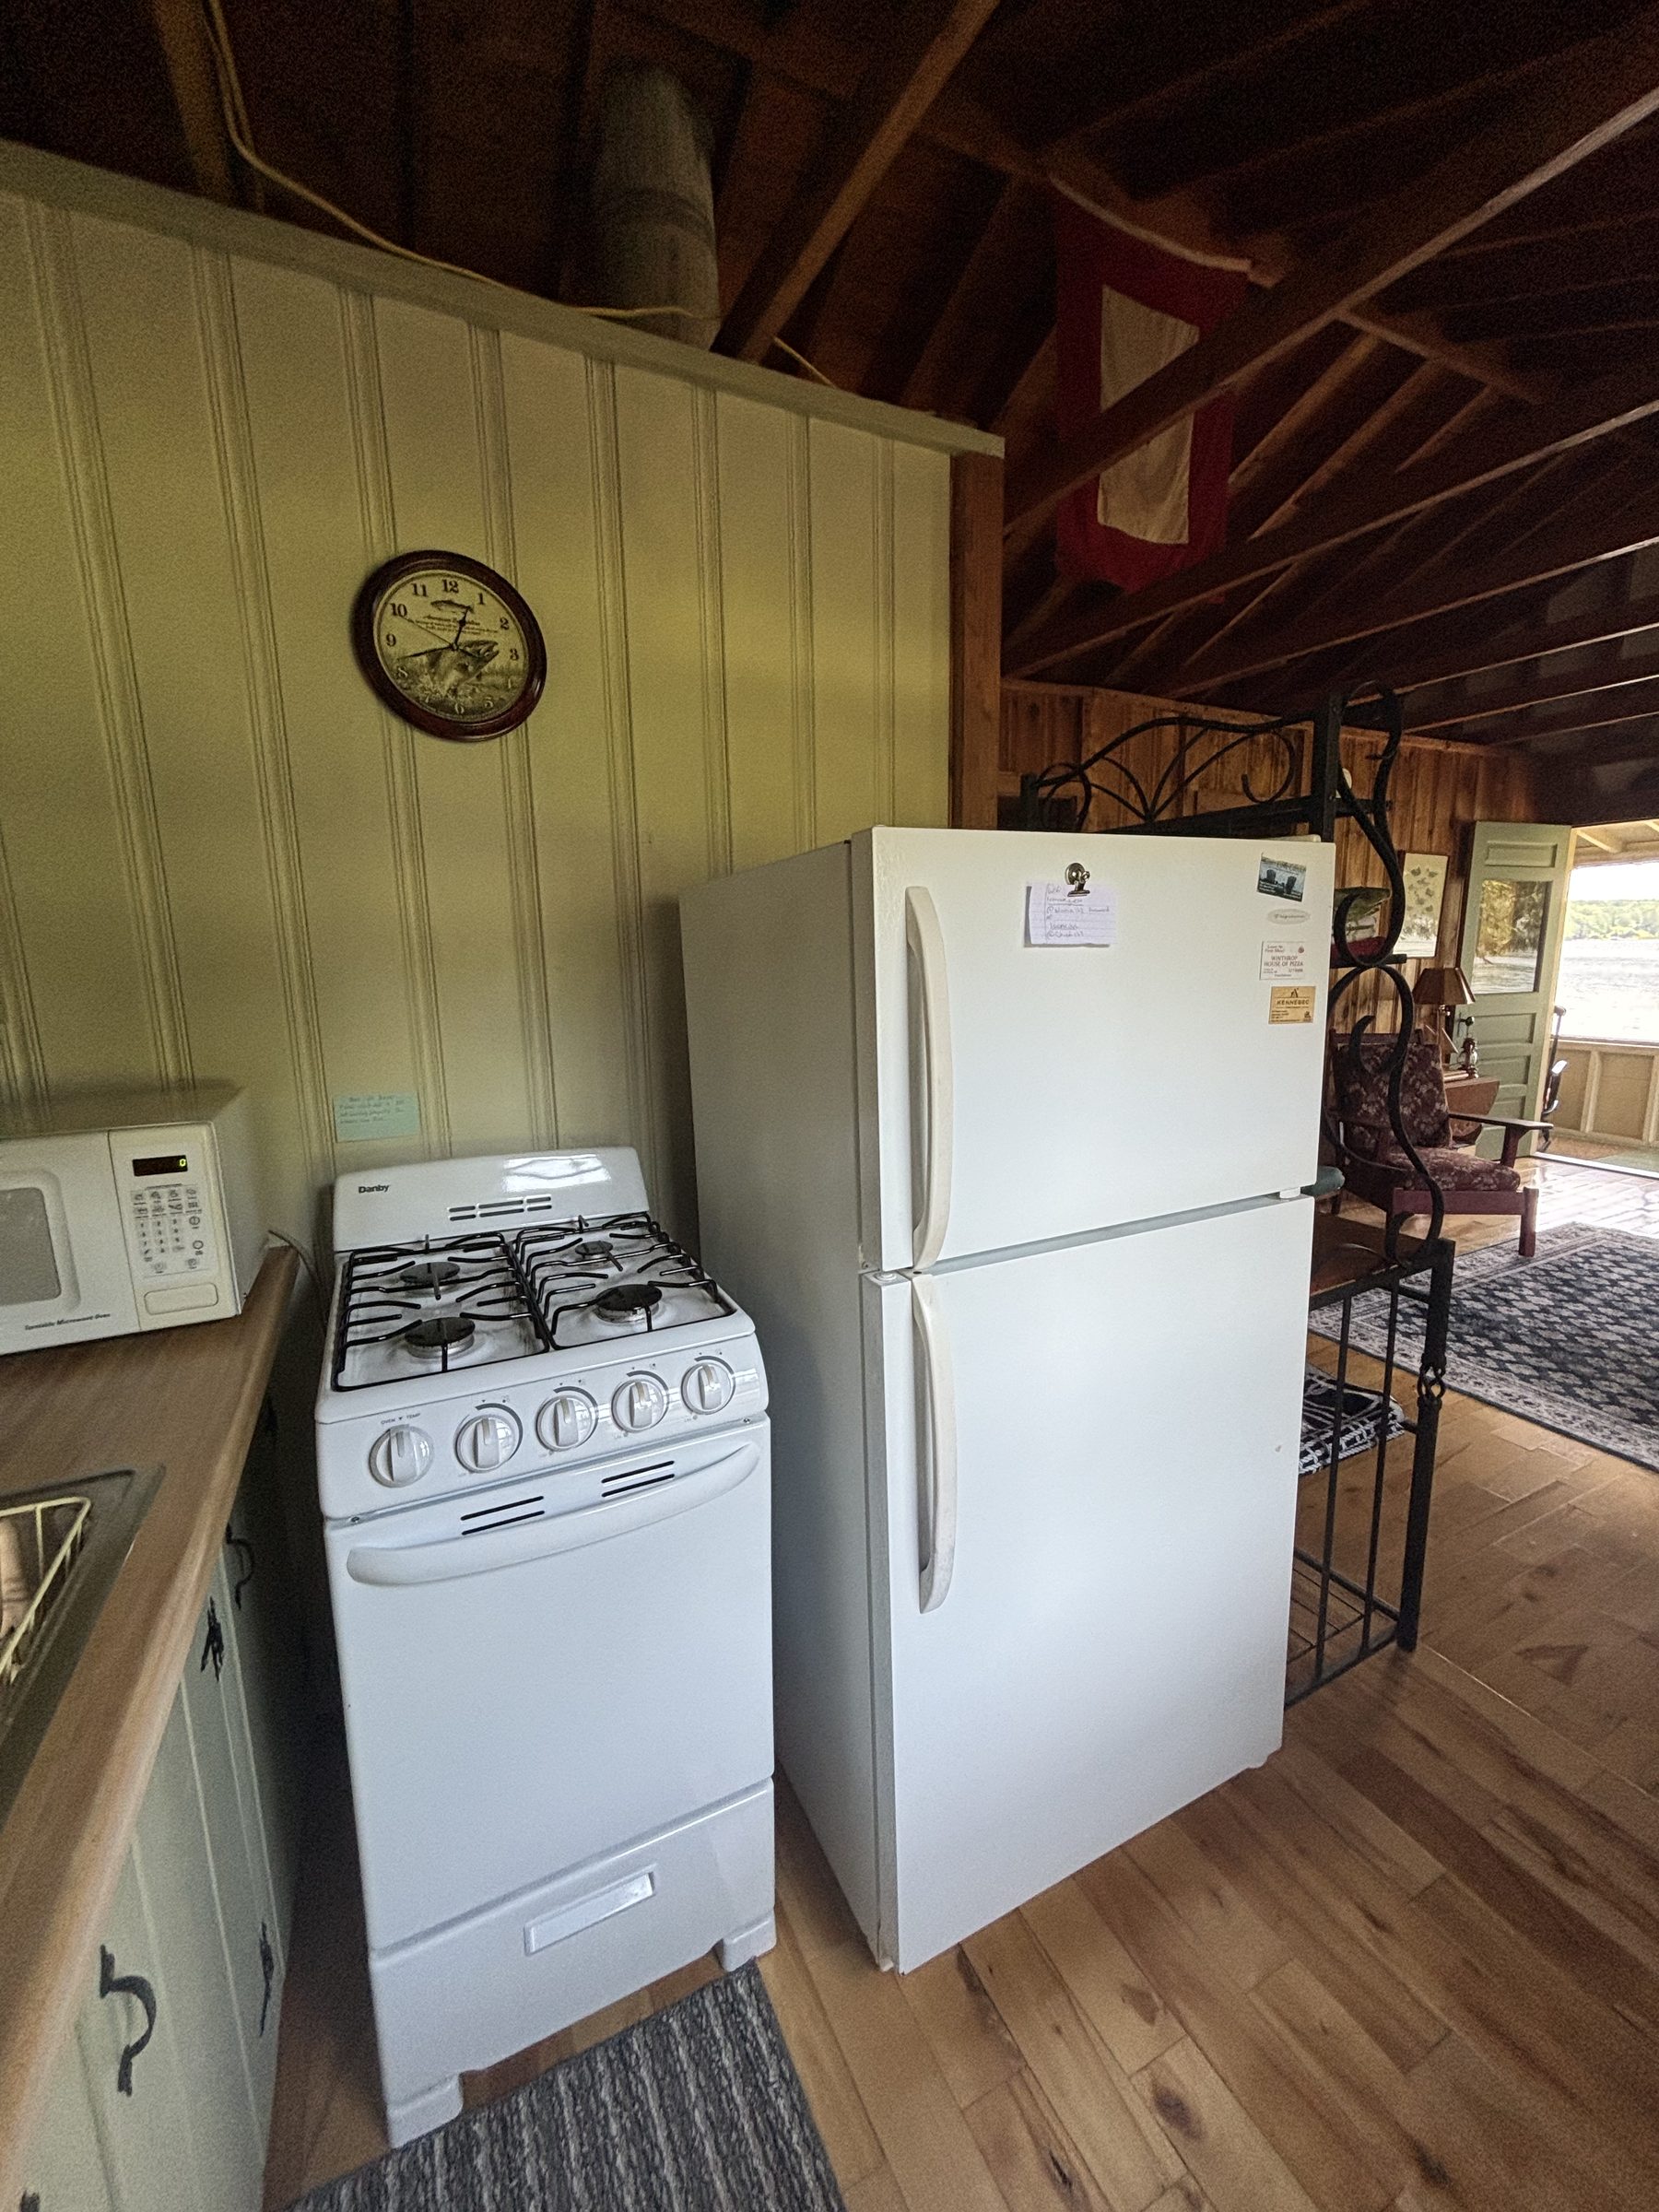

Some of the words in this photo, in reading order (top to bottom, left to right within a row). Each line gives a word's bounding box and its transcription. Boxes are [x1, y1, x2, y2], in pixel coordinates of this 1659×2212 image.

[411, 582, 428, 597] 11
[442, 579, 459, 594] 12
[478, 593, 486, 605] 1
[390, 603, 407, 618] 10
[500, 617, 509, 630] 2
[385, 634, 396, 646] 9
[510, 648, 519, 661] 3
[396, 665, 408, 678] 8
[454, 702, 465, 715] 6
[484, 697, 494, 709] 5
[179, 1159, 186, 1167] 0
[359, 1184, 390, 1194] Danby
[57, 1315, 94, 1325] Microwave
